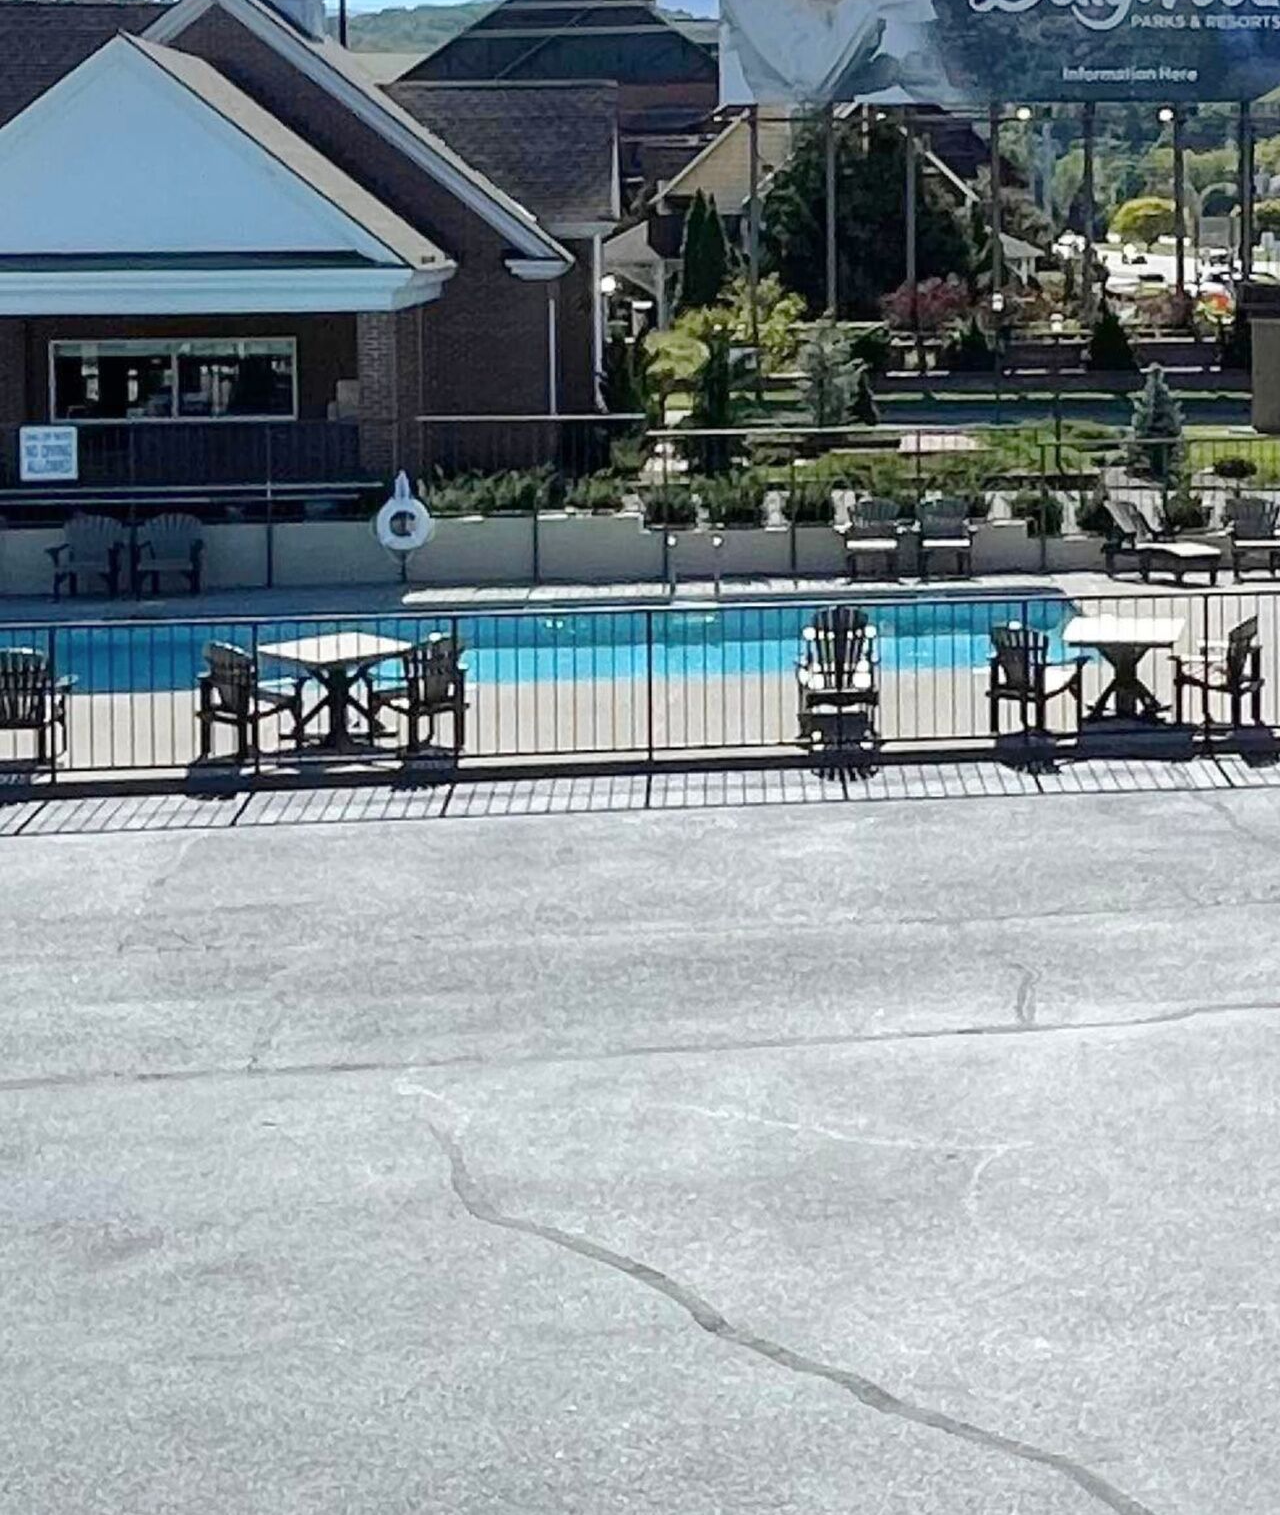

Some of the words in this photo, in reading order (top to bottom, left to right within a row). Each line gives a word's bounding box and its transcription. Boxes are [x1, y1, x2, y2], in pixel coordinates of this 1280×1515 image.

[1131, 15, 1186, 29] PARKS
[1190, 15, 1201, 29] &
[1063, 67, 1157, 82] Information
[1159, 68, 1198, 83] Here
